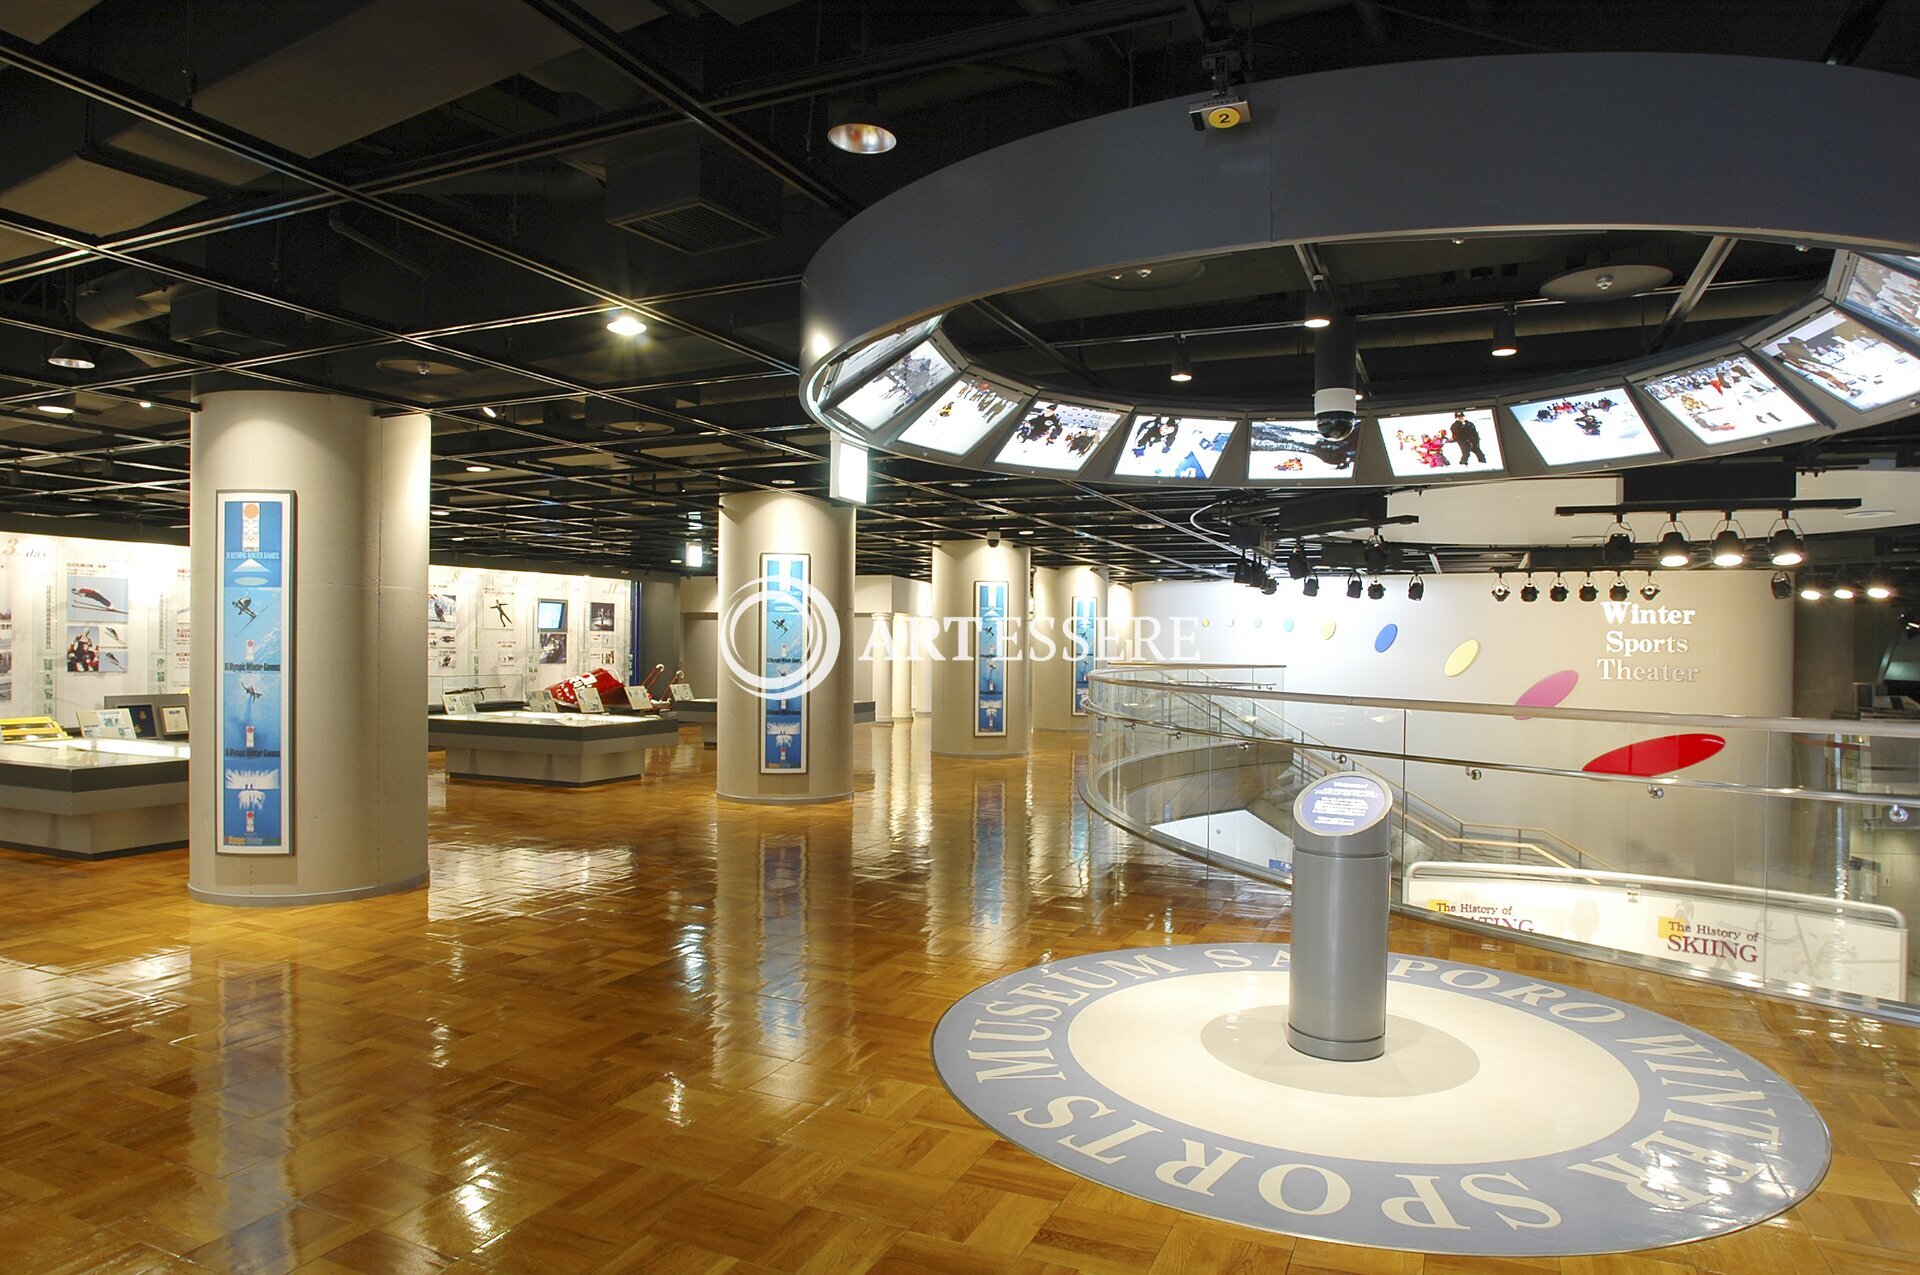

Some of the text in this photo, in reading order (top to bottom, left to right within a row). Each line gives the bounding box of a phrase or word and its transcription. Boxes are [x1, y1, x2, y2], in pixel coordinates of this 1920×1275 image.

[1218, 113, 1230, 124] 2
[1600, 601, 1696, 625] Winter
[1606, 630, 1688, 657] Sports
[1597, 658, 1699, 682] Theater
[1436, 903, 1513, 916] The History of
[1668, 921, 1760, 942] The History of
[1667, 934, 1758, 963] SKIING
[966, 948, 1782, 1230] SAPORO WINTER SPORTS MUSEUM
